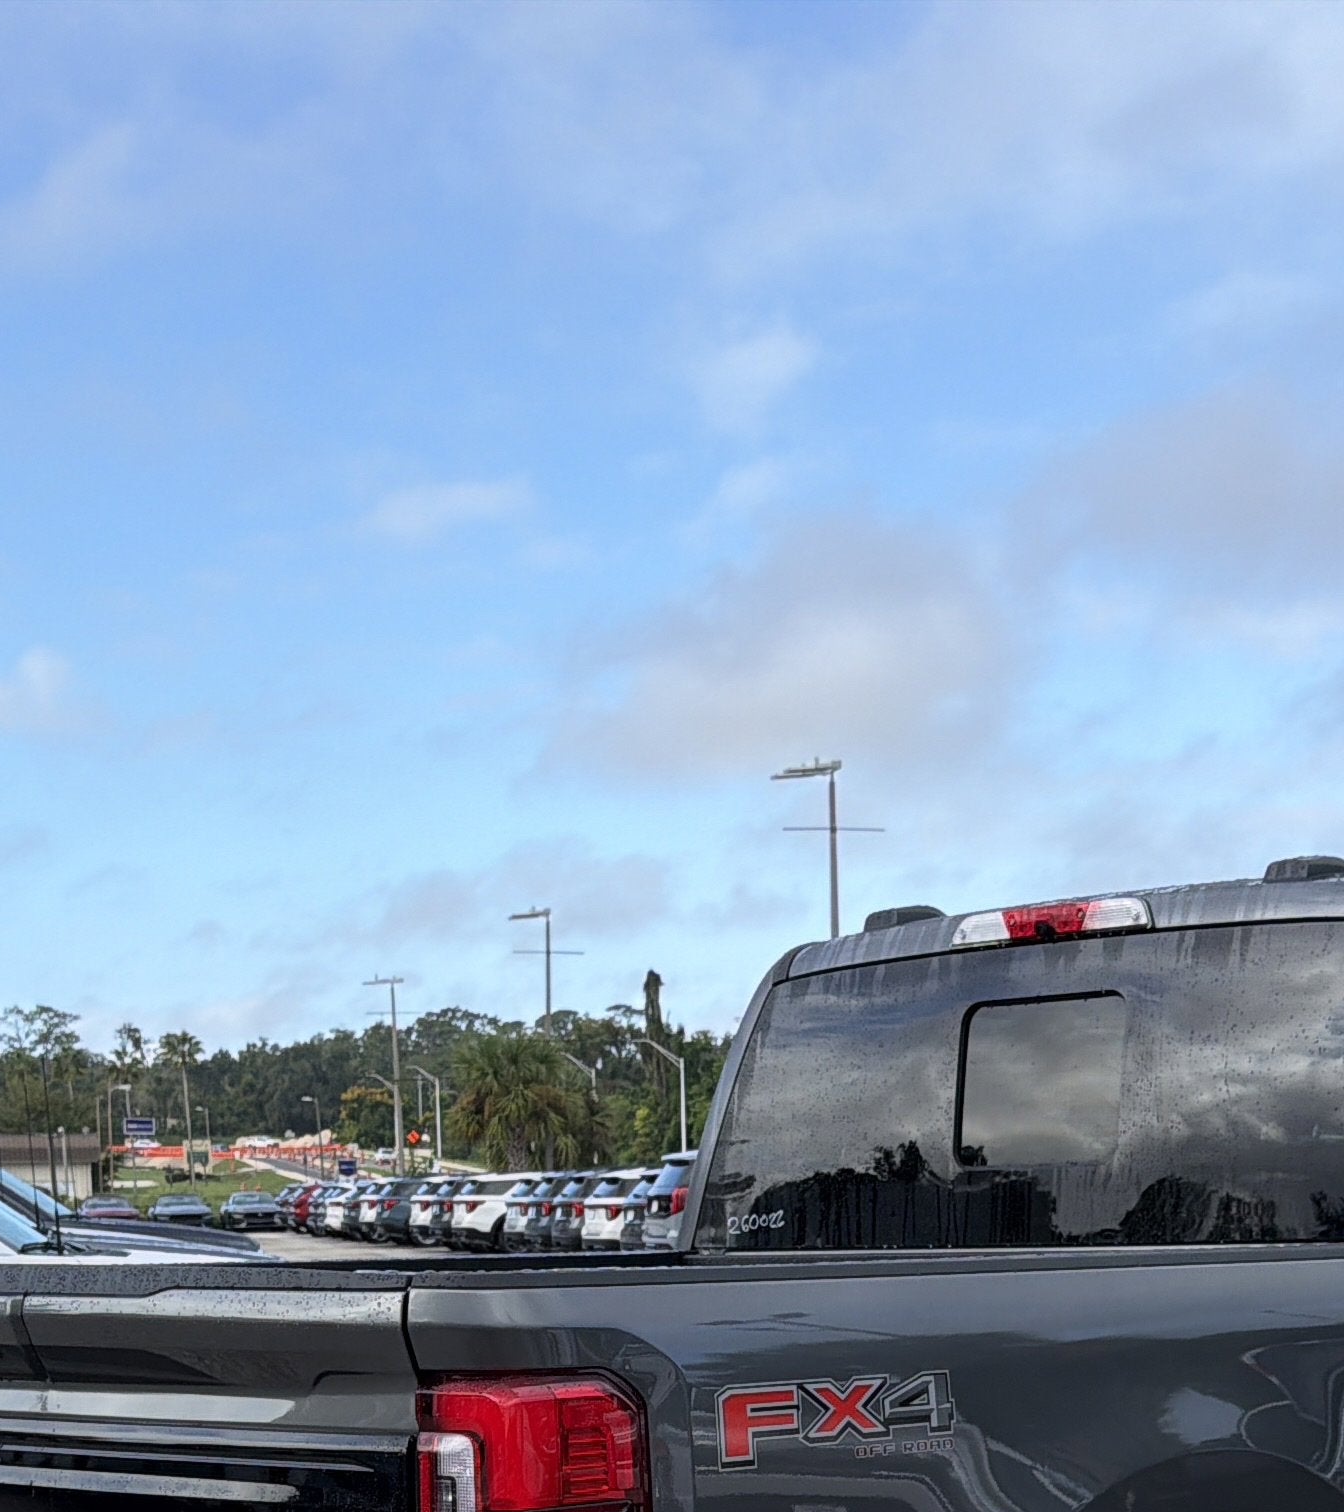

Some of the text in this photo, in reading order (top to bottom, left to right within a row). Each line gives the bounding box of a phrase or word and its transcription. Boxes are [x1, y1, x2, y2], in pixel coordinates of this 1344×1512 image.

[727, 1209, 785, 1235] 260022
[714, 1370, 955, 1472] FX4
[855, 1437, 955, 1459] OFF ROAD
